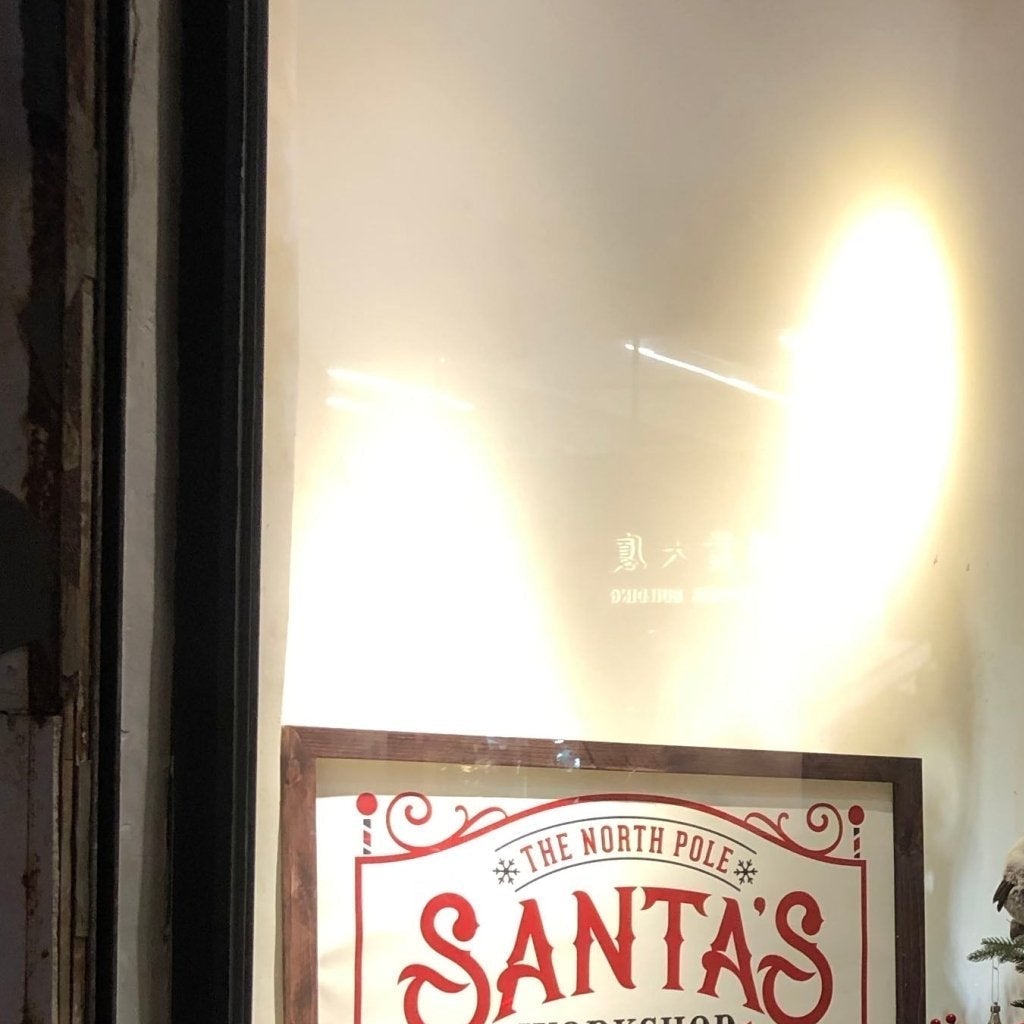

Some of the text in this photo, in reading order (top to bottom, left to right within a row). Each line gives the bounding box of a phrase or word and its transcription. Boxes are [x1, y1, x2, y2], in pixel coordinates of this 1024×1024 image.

[520, 824, 734, 874] THE NORTH POLE
